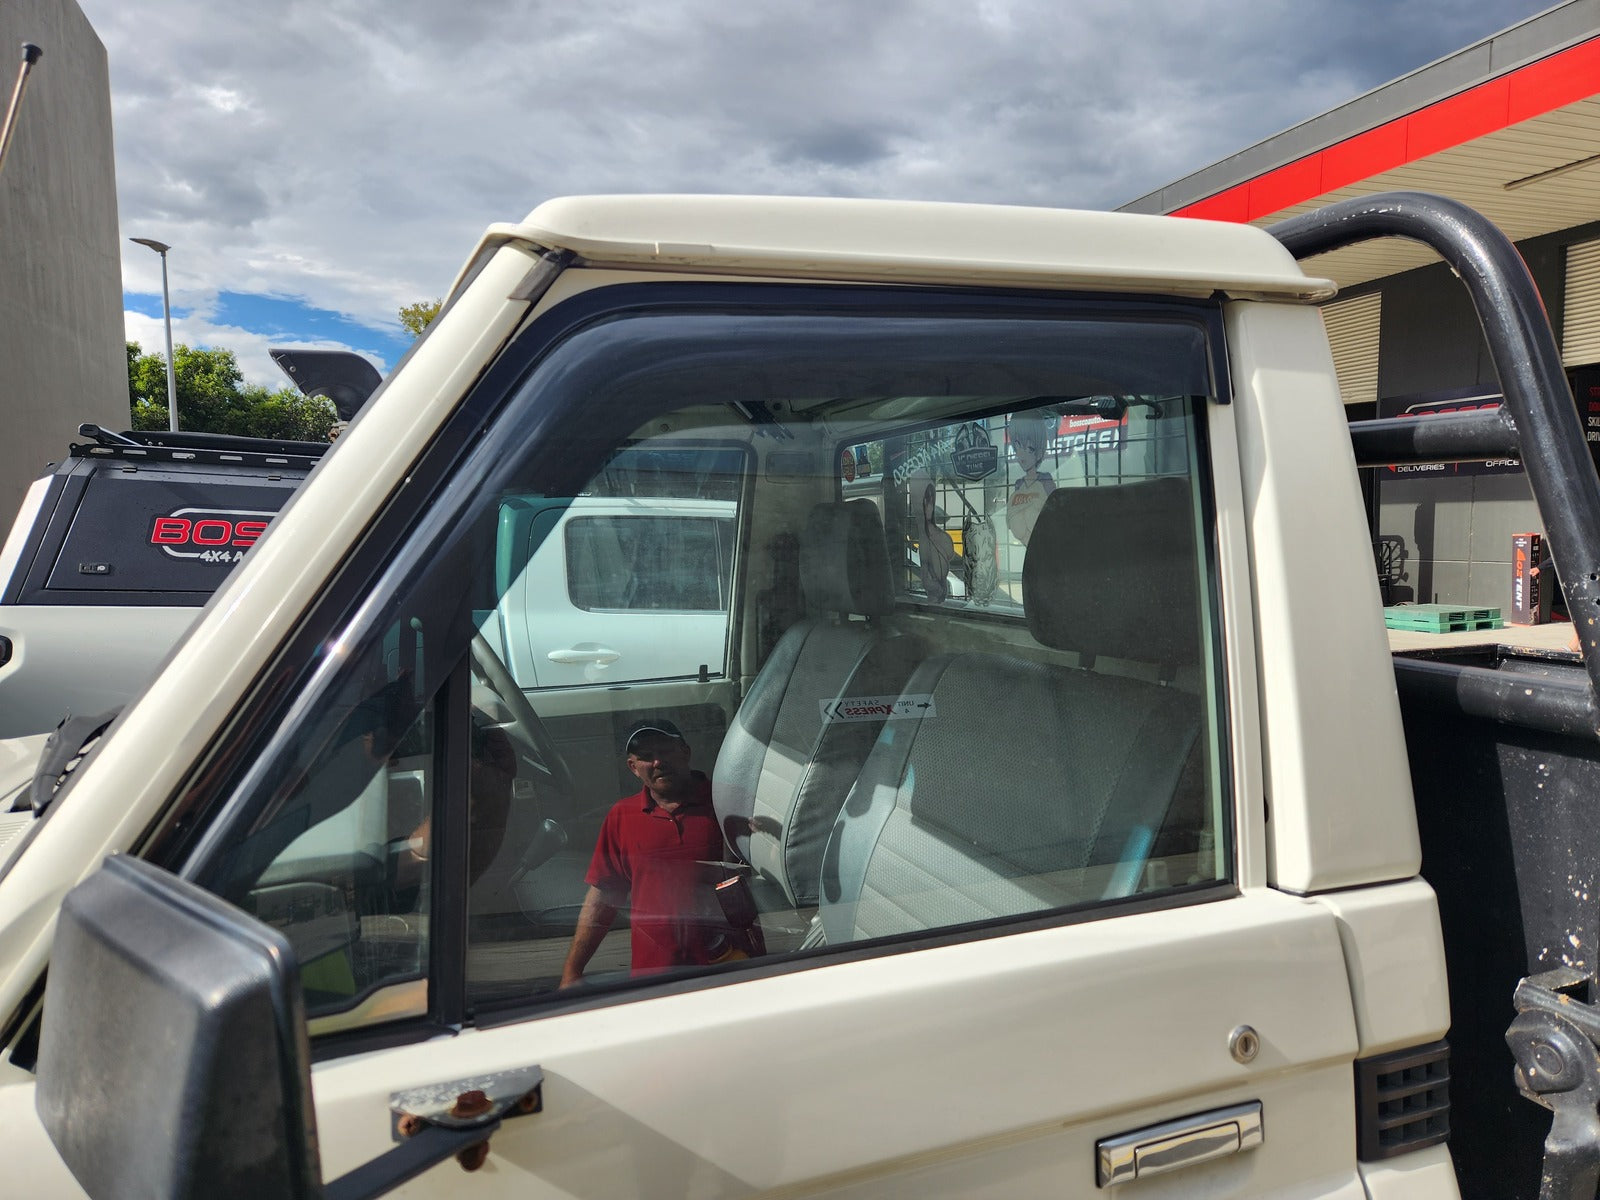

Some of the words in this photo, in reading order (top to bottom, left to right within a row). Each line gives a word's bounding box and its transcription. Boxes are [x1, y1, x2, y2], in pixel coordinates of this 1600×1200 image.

[1397, 463, 1445, 473] DELIVERIES
[1485, 459, 1519, 468] OFFICE
[199, 550, 231, 563] 4X4
